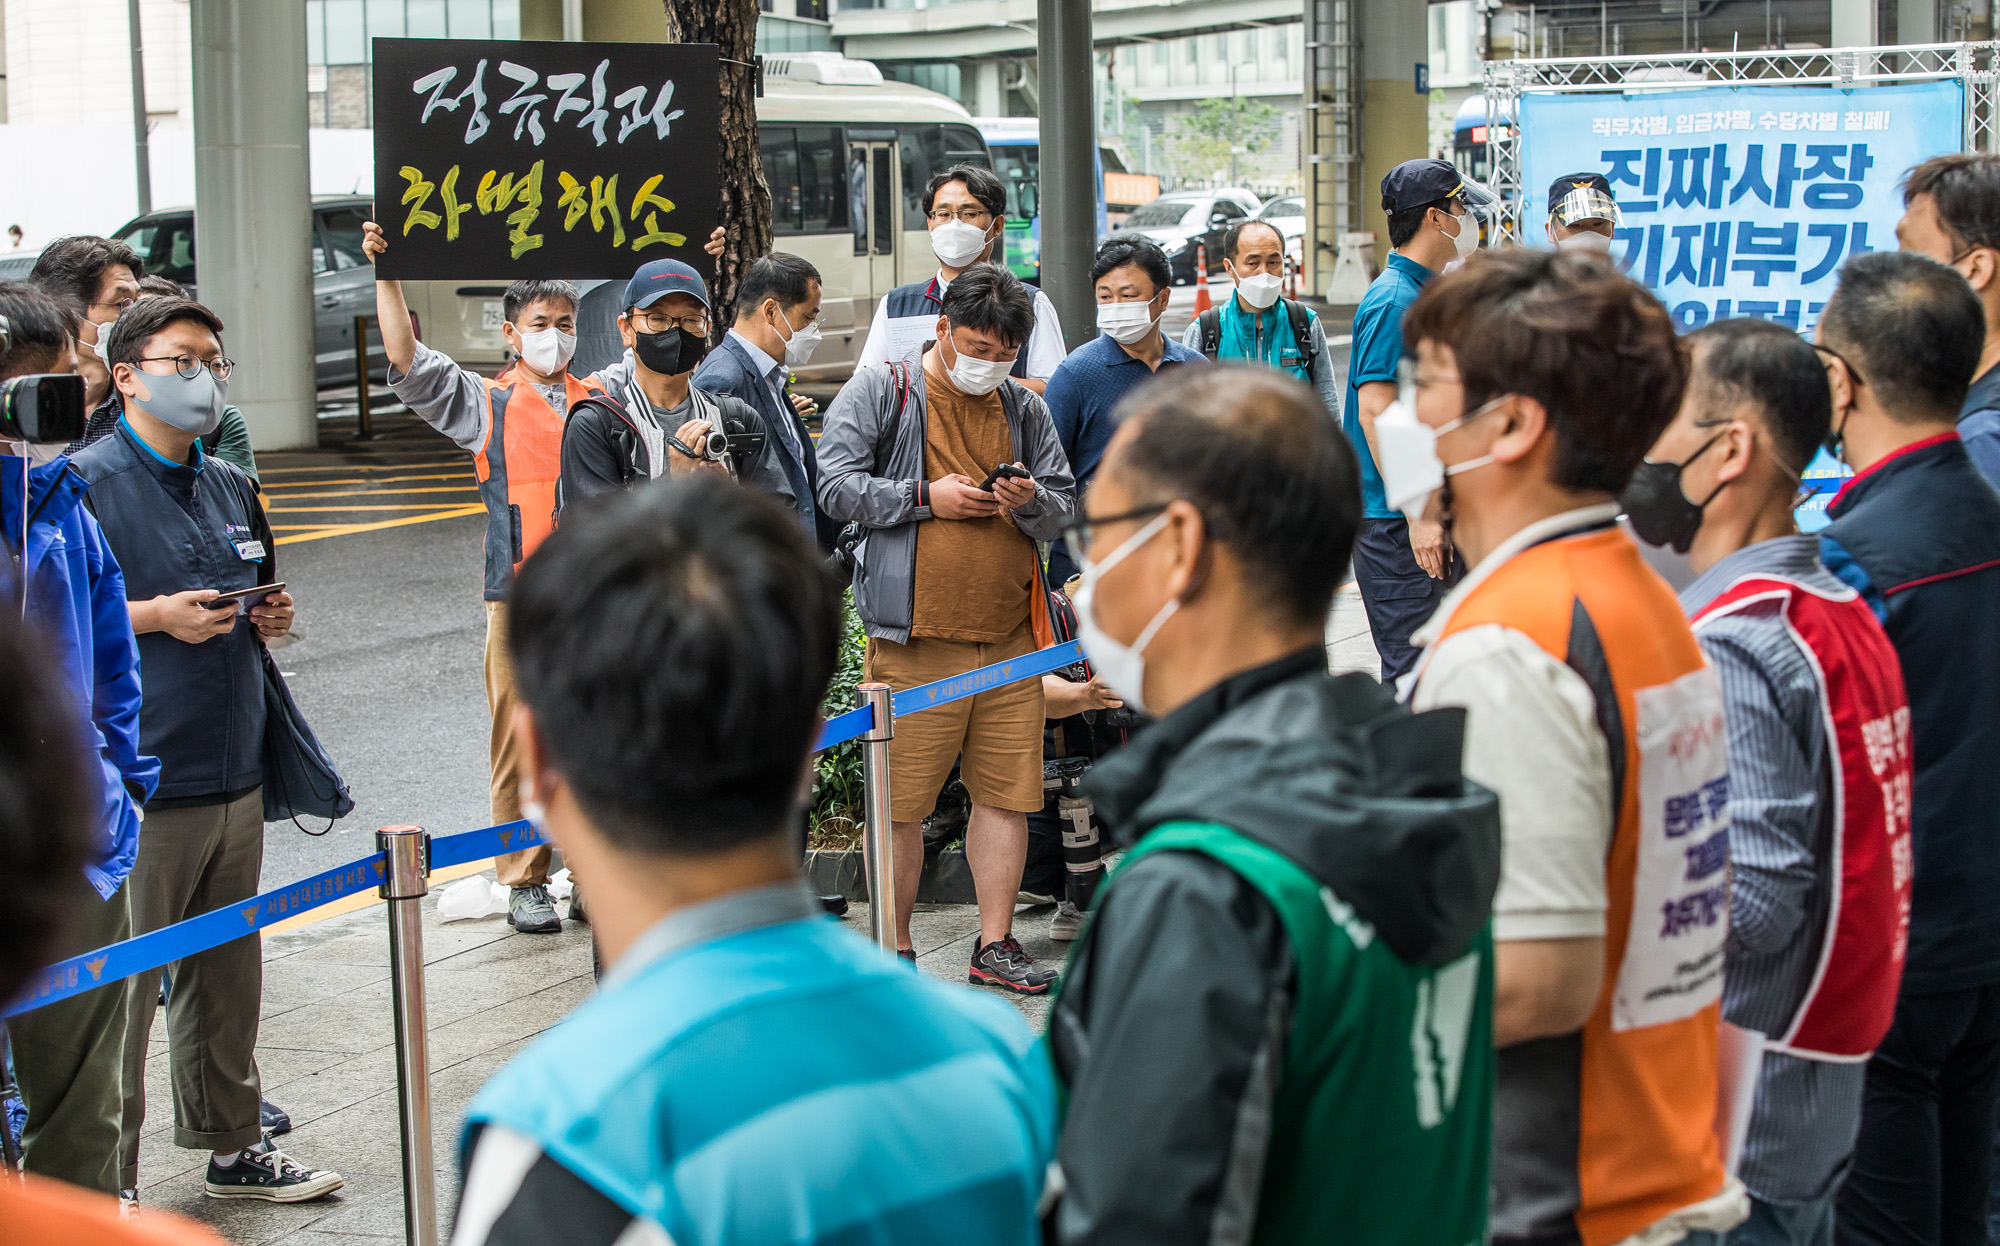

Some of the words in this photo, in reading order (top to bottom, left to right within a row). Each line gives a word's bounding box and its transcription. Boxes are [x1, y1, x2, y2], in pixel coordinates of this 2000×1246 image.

[412, 58, 685, 147] 정규직과
[1592, 114, 1673, 138] 직무차별,
[1676, 109, 1755, 134] 임금차별,
[1758, 110, 1839, 132] 수당차별
[1844, 110, 1891, 131] 철폐!
[399, 159, 544, 260] 차별
[557, 170, 687, 251] 해소
[1600, 143, 1874, 213] 진짜사장
[267, 866, 366, 915] 서울남대문경찰서장
